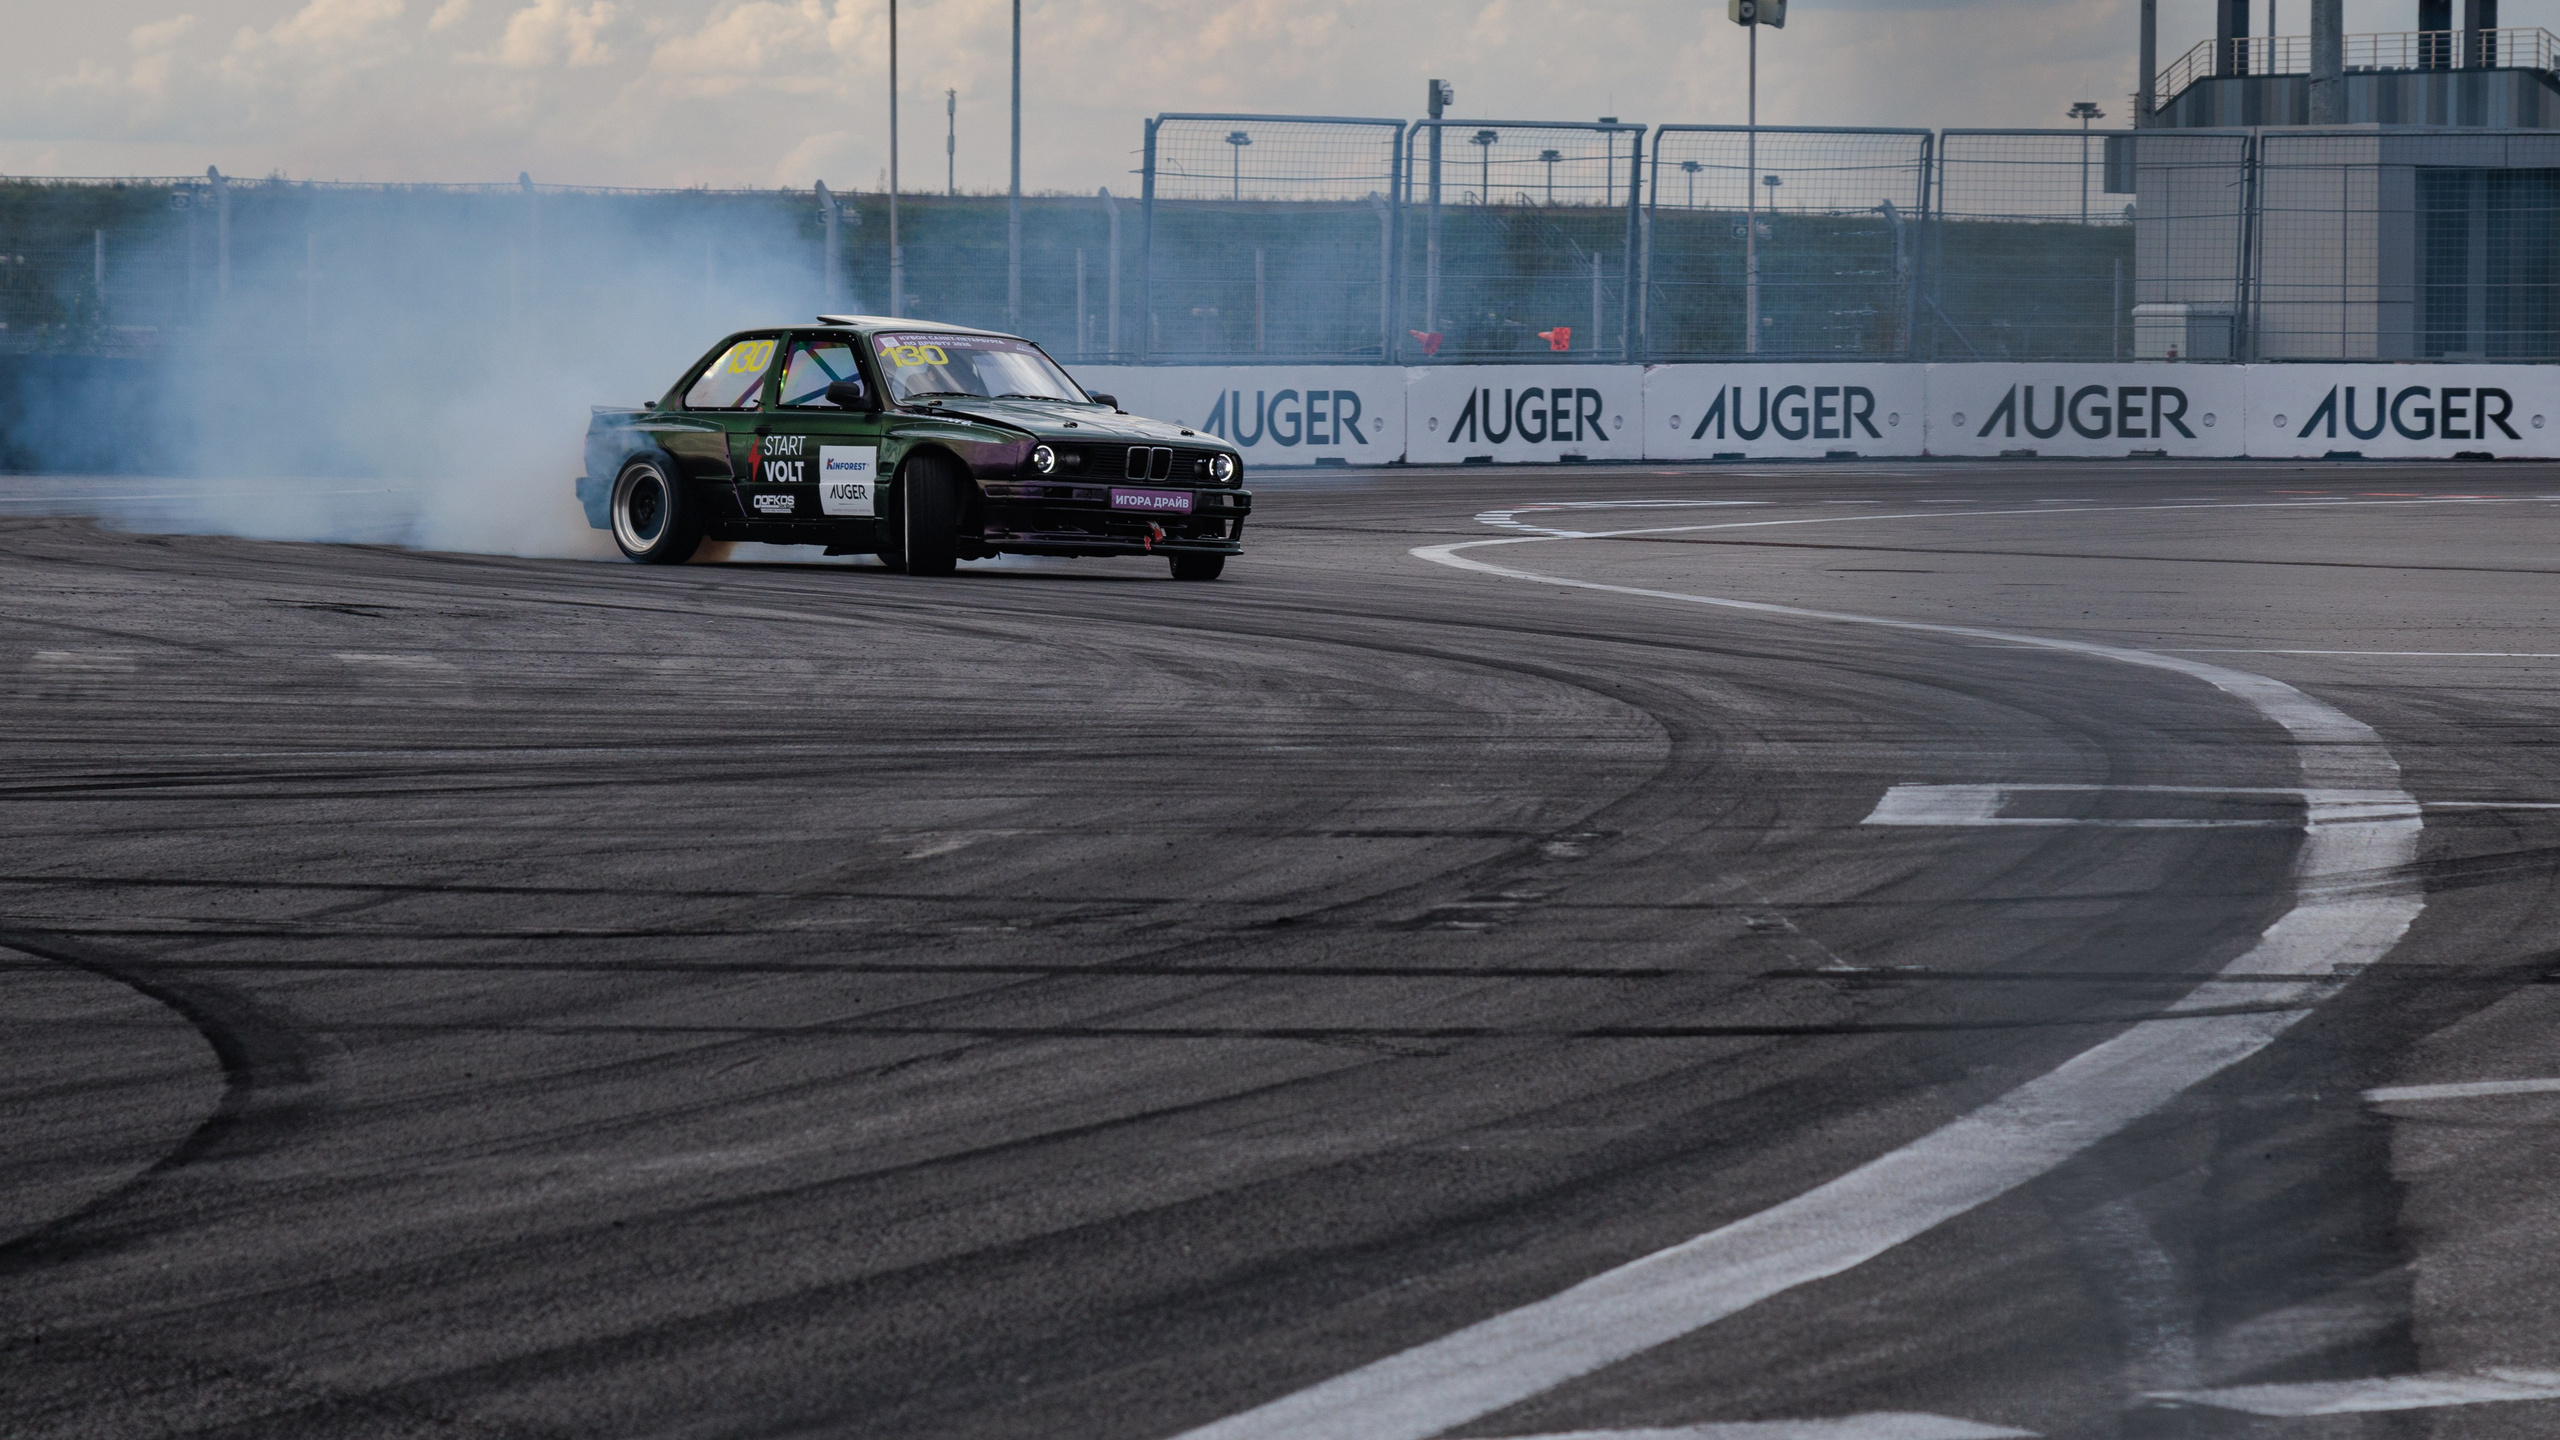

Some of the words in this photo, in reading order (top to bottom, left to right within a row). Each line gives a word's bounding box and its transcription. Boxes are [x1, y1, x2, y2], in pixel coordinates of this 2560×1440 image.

[727, 340, 774, 374] 130
[880, 345, 949, 368] 130
[1201, 387, 1369, 447] AUGER
[1447, 385, 1610, 444] AUGER
[1690, 383, 1883, 441] AUGER
[1976, 382, 2197, 440] AUGER
[2296, 382, 2523, 441] AUGER
[764, 435, 806, 456] START
[763, 460, 805, 483] VOLT
[826, 458, 867, 470] KINFOREST
[829, 484, 868, 500] AUGER
[1115, 494, 1152, 506] ИГОРА
[1153, 496, 1190, 508] ДРАЙВ
